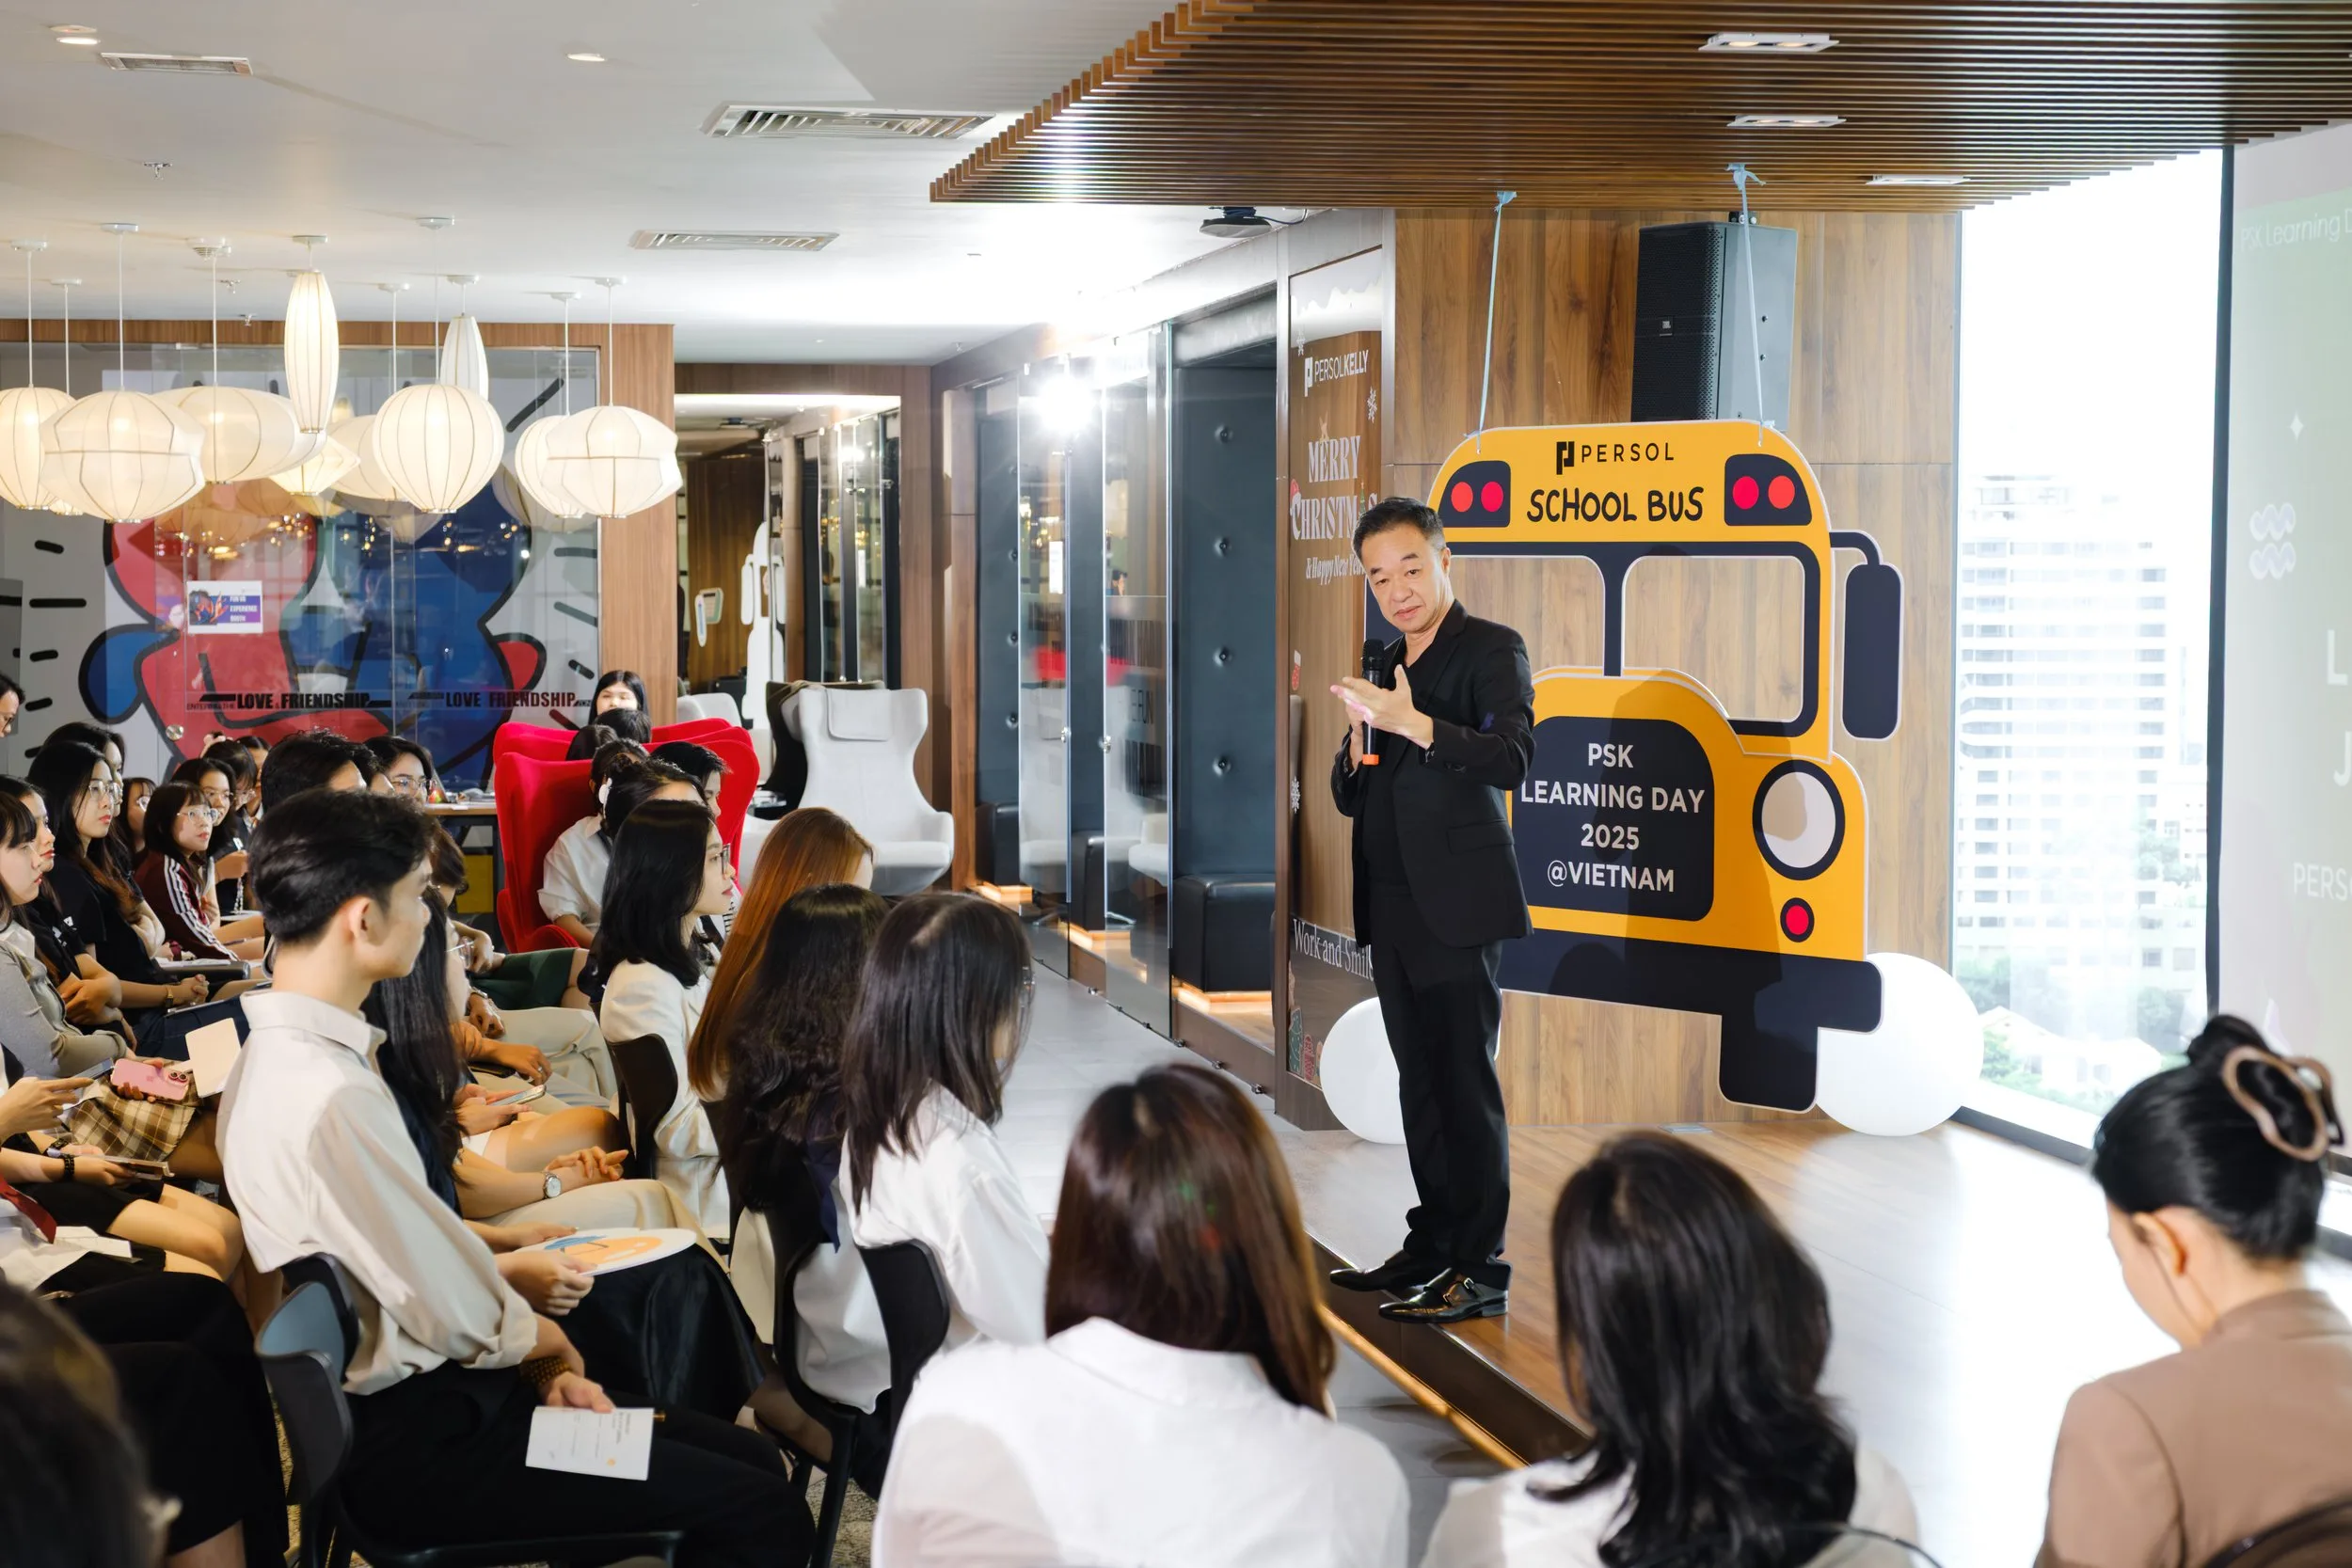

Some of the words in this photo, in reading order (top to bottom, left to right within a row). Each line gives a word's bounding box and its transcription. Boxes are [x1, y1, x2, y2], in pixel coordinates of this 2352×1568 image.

[2265, 213, 2340, 246] Learning
[1314, 350, 1369, 382] PERSOLKELLY
[1309, 436, 1360, 483] MERRY
[1581, 442, 1675, 463] PERSOL
[1527, 486, 1638, 523] SCHOOL
[1647, 486, 1705, 522] BUS
[1312, 557, 1334, 586] Happy
[237, 693, 273, 709] LOVE
[281, 693, 370, 709] FRIENDSHIP
[446, 692, 481, 707] LOVE
[489, 692, 575, 707] FRIENDSHIP
[1588, 743, 1634, 768] PSK
[1520, 780, 1644, 810] LEARNING
[1651, 787, 1705, 814] DAY
[1581, 823, 1640, 850] 2025
[1547, 860, 1675, 893] @VIETNAM
[1294, 919, 1321, 959] Work
[1323, 933, 1343, 968] and
